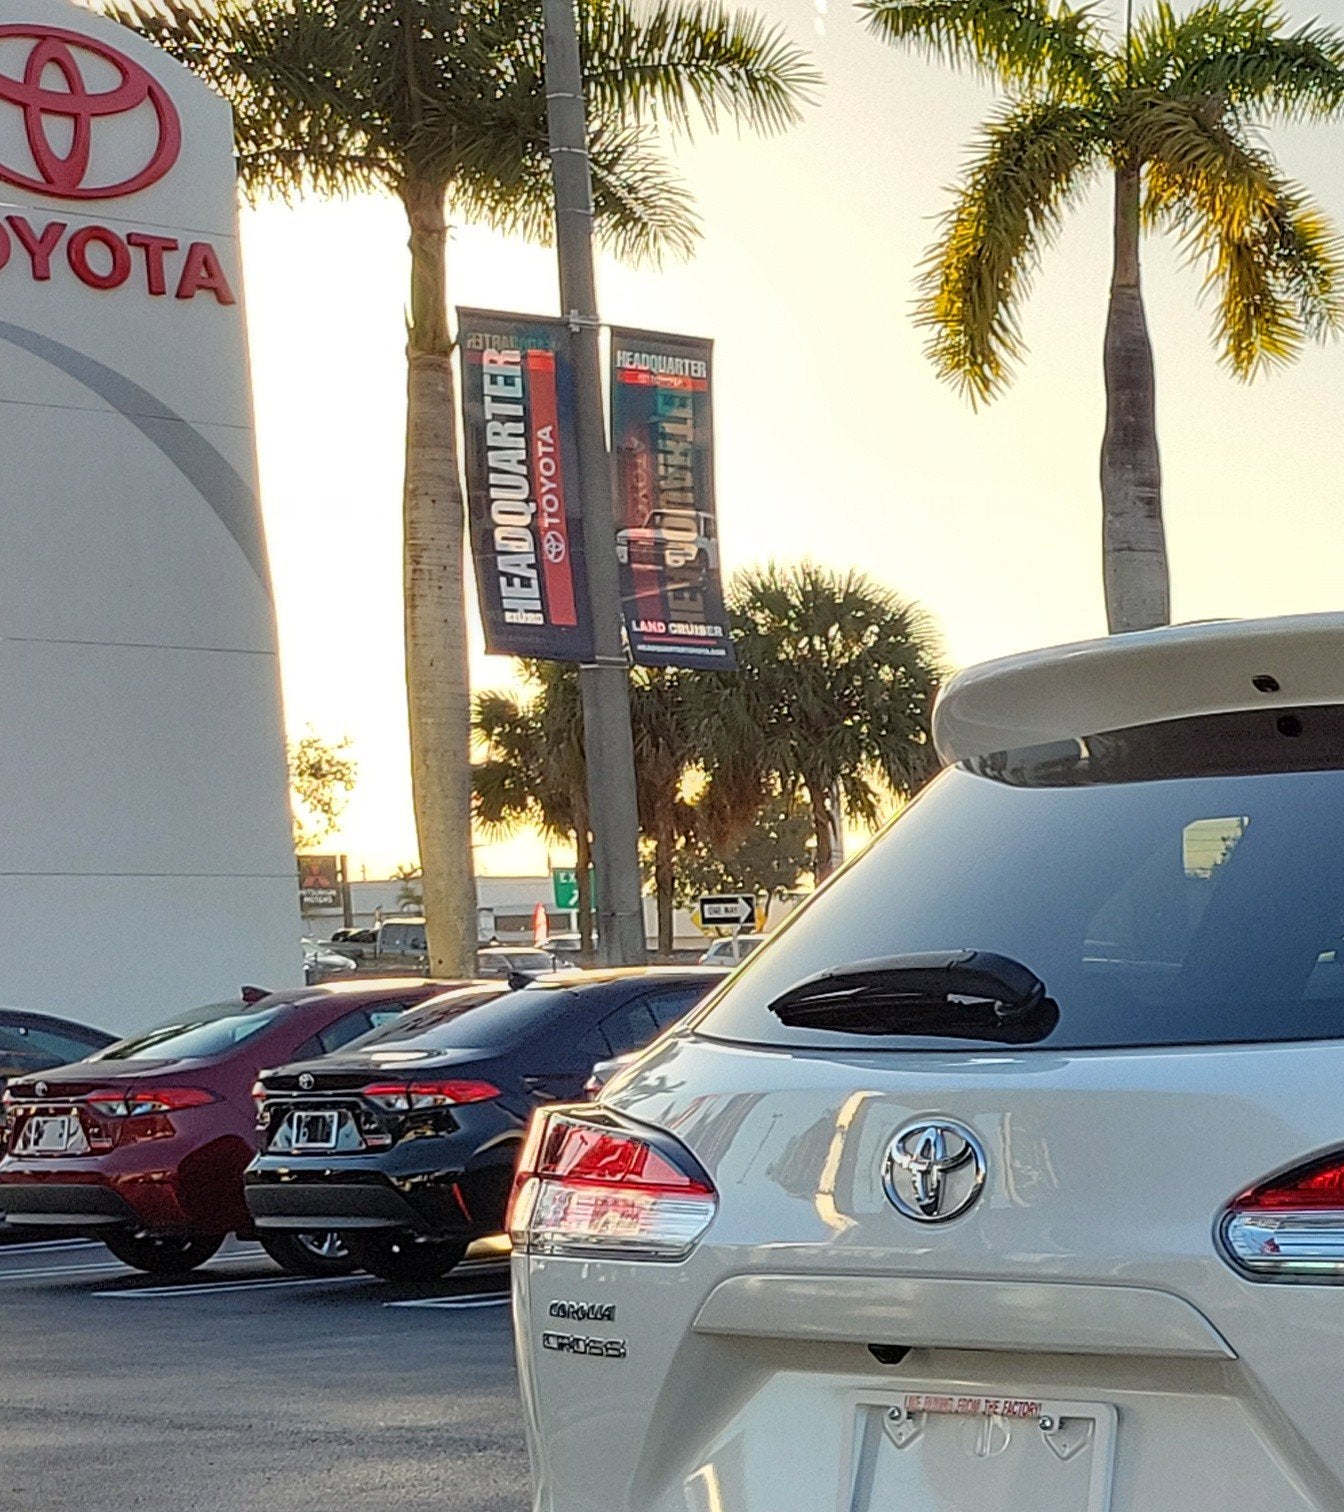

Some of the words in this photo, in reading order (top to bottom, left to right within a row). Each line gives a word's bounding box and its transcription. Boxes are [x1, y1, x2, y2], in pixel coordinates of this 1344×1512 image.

[0, 214, 236, 305] YOTA
[615, 350, 707, 379] HEADQUARTER
[482, 347, 545, 626] HEADQUARTER
[536, 425, 560, 528] TOYOTA
[631, 619, 667, 634] LAND
[668, 621, 724, 637] CRUISER
[549, 1299, 617, 1322] COROLLA
[543, 1330, 627, 1359] CROSS
[983, 1398, 1001, 1416] THE
